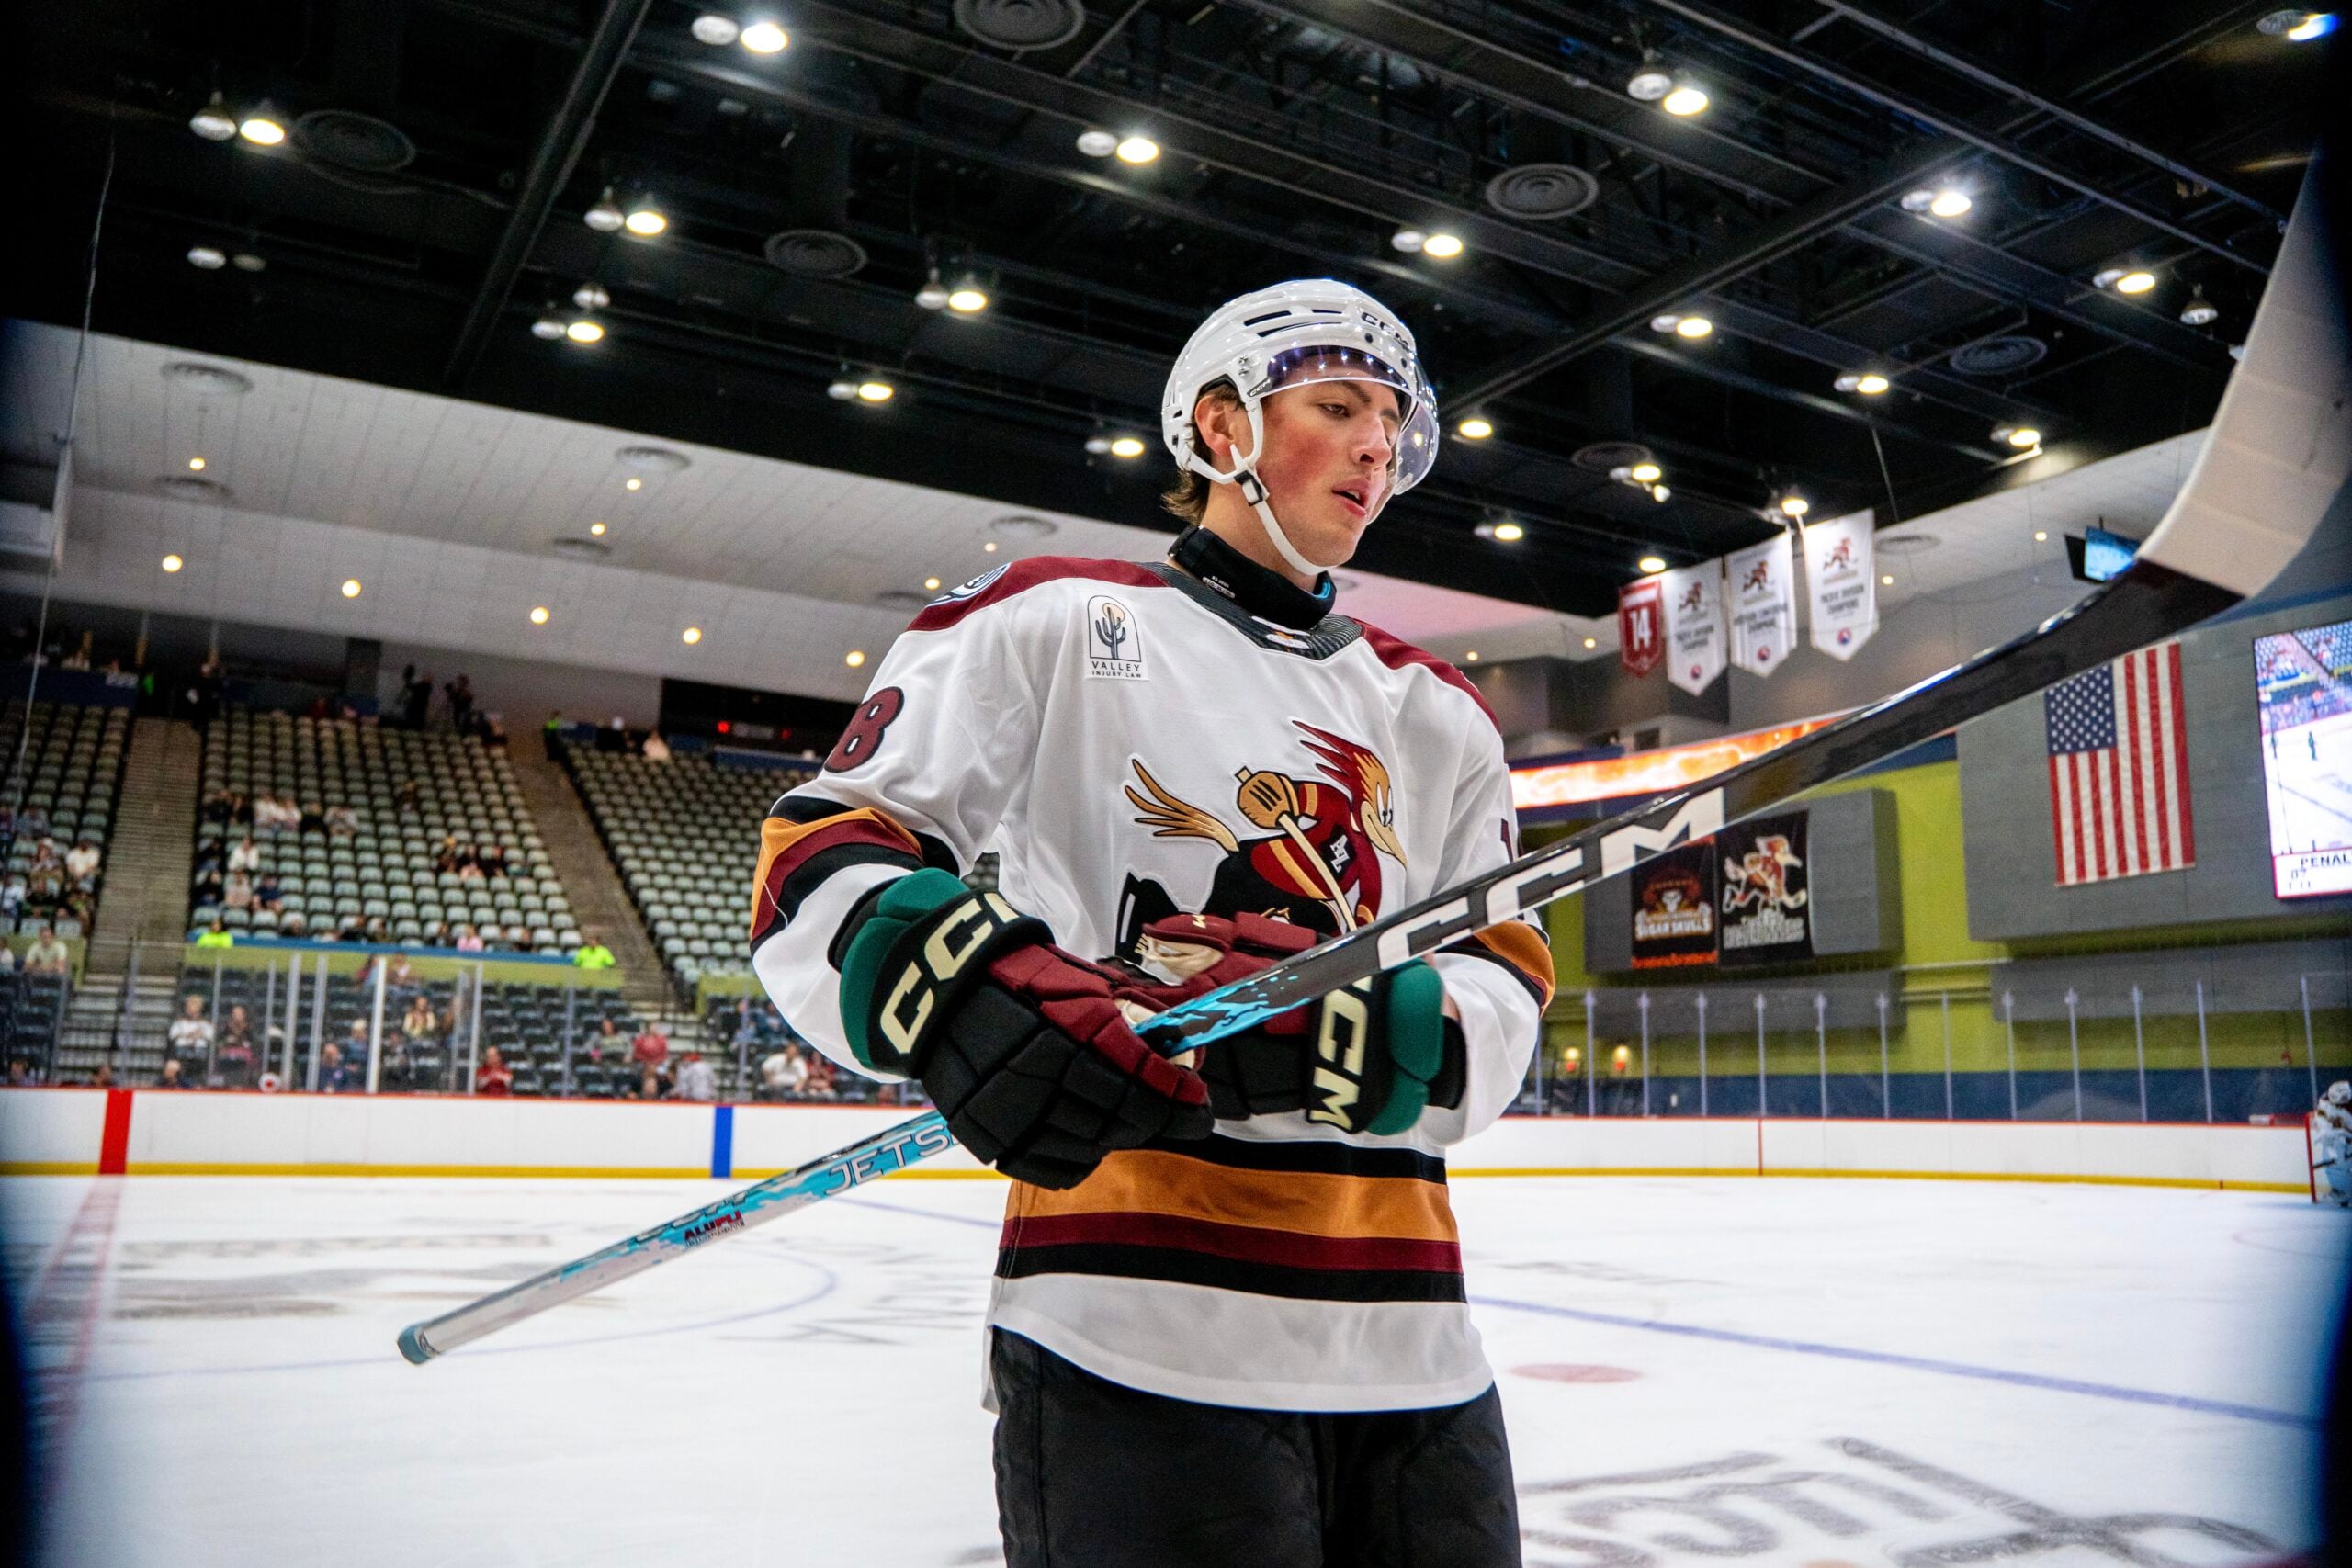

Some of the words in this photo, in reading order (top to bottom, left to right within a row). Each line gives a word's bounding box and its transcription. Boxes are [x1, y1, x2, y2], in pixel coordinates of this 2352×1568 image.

[1628, 607, 1652, 652] 14
[1091, 660, 1139, 672] VALLEY
[1091, 670, 1122, 678] INJURY
[1377, 787, 1724, 971] CCM
[1309, 976, 1373, 1132] CM
[824, 1122, 960, 1196] JETS
